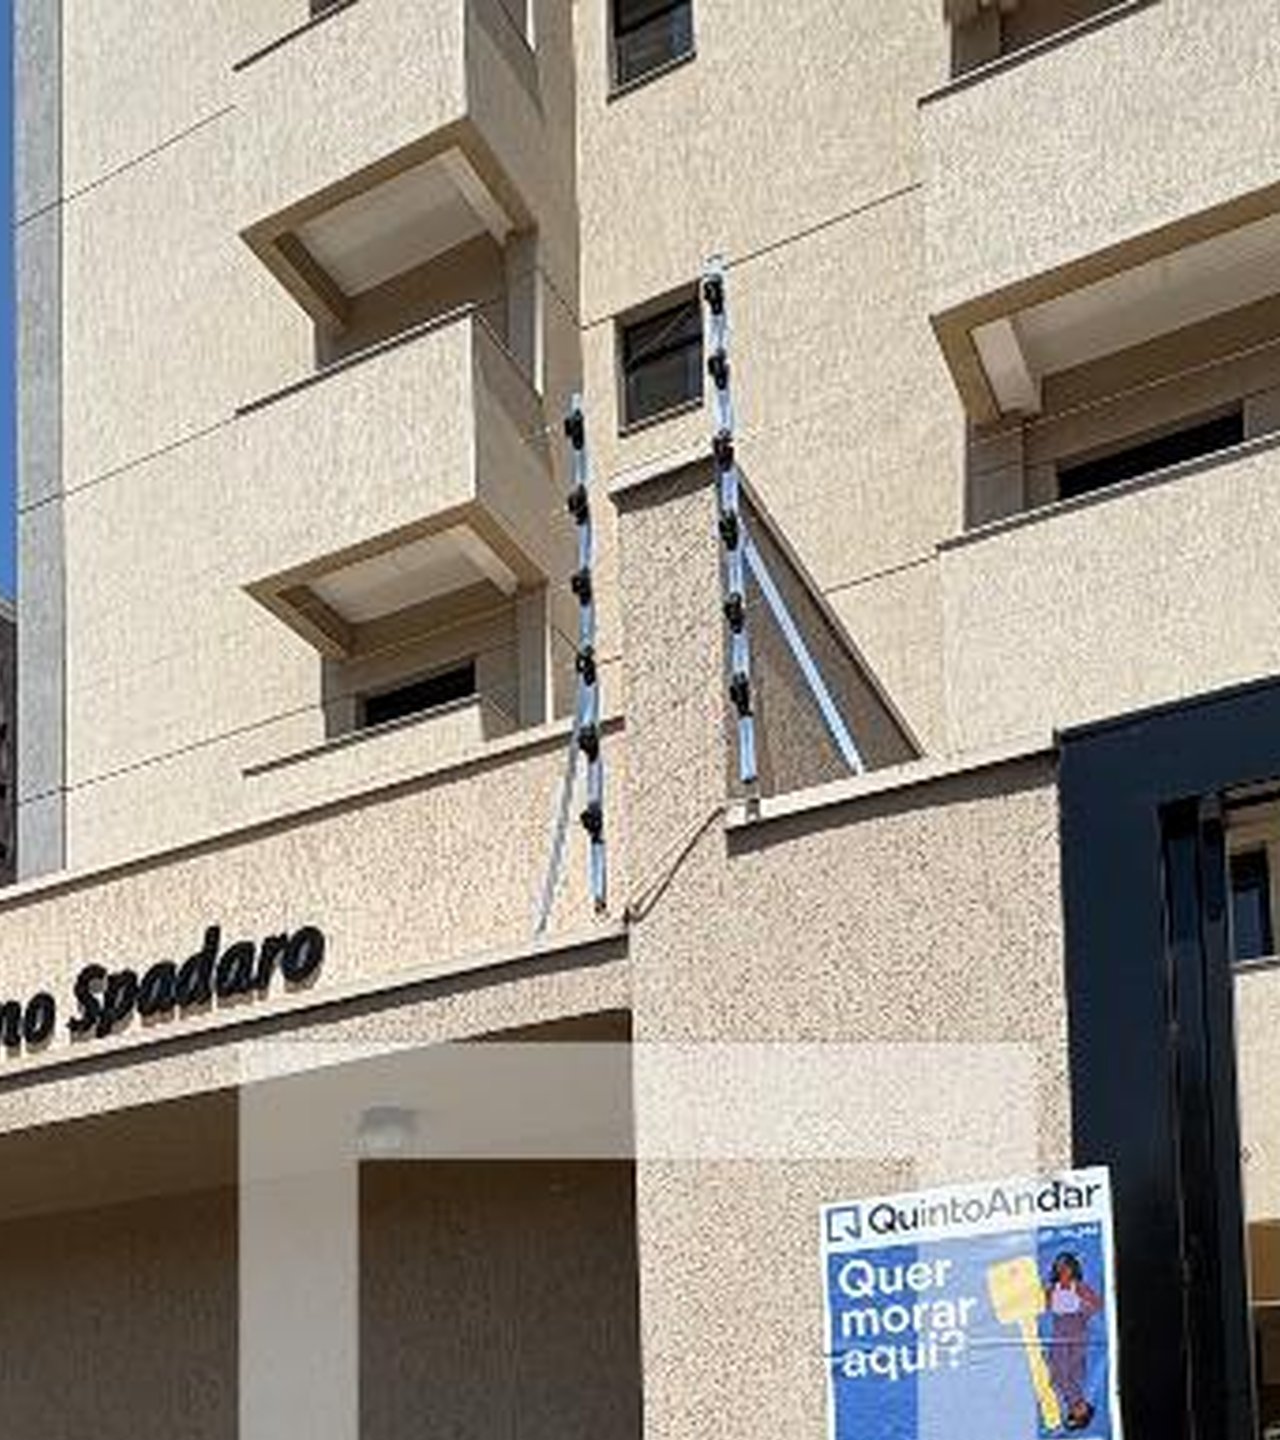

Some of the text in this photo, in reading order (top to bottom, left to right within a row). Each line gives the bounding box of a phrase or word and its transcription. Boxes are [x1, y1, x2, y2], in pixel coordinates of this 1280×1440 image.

[66, 924, 323, 1037] Spadaro
[868, 1180, 1102, 1235] QuintoAndar
[838, 1258, 952, 1298] Quer
[842, 1297, 977, 1337] morar
[842, 1328, 965, 1381] aqui?
